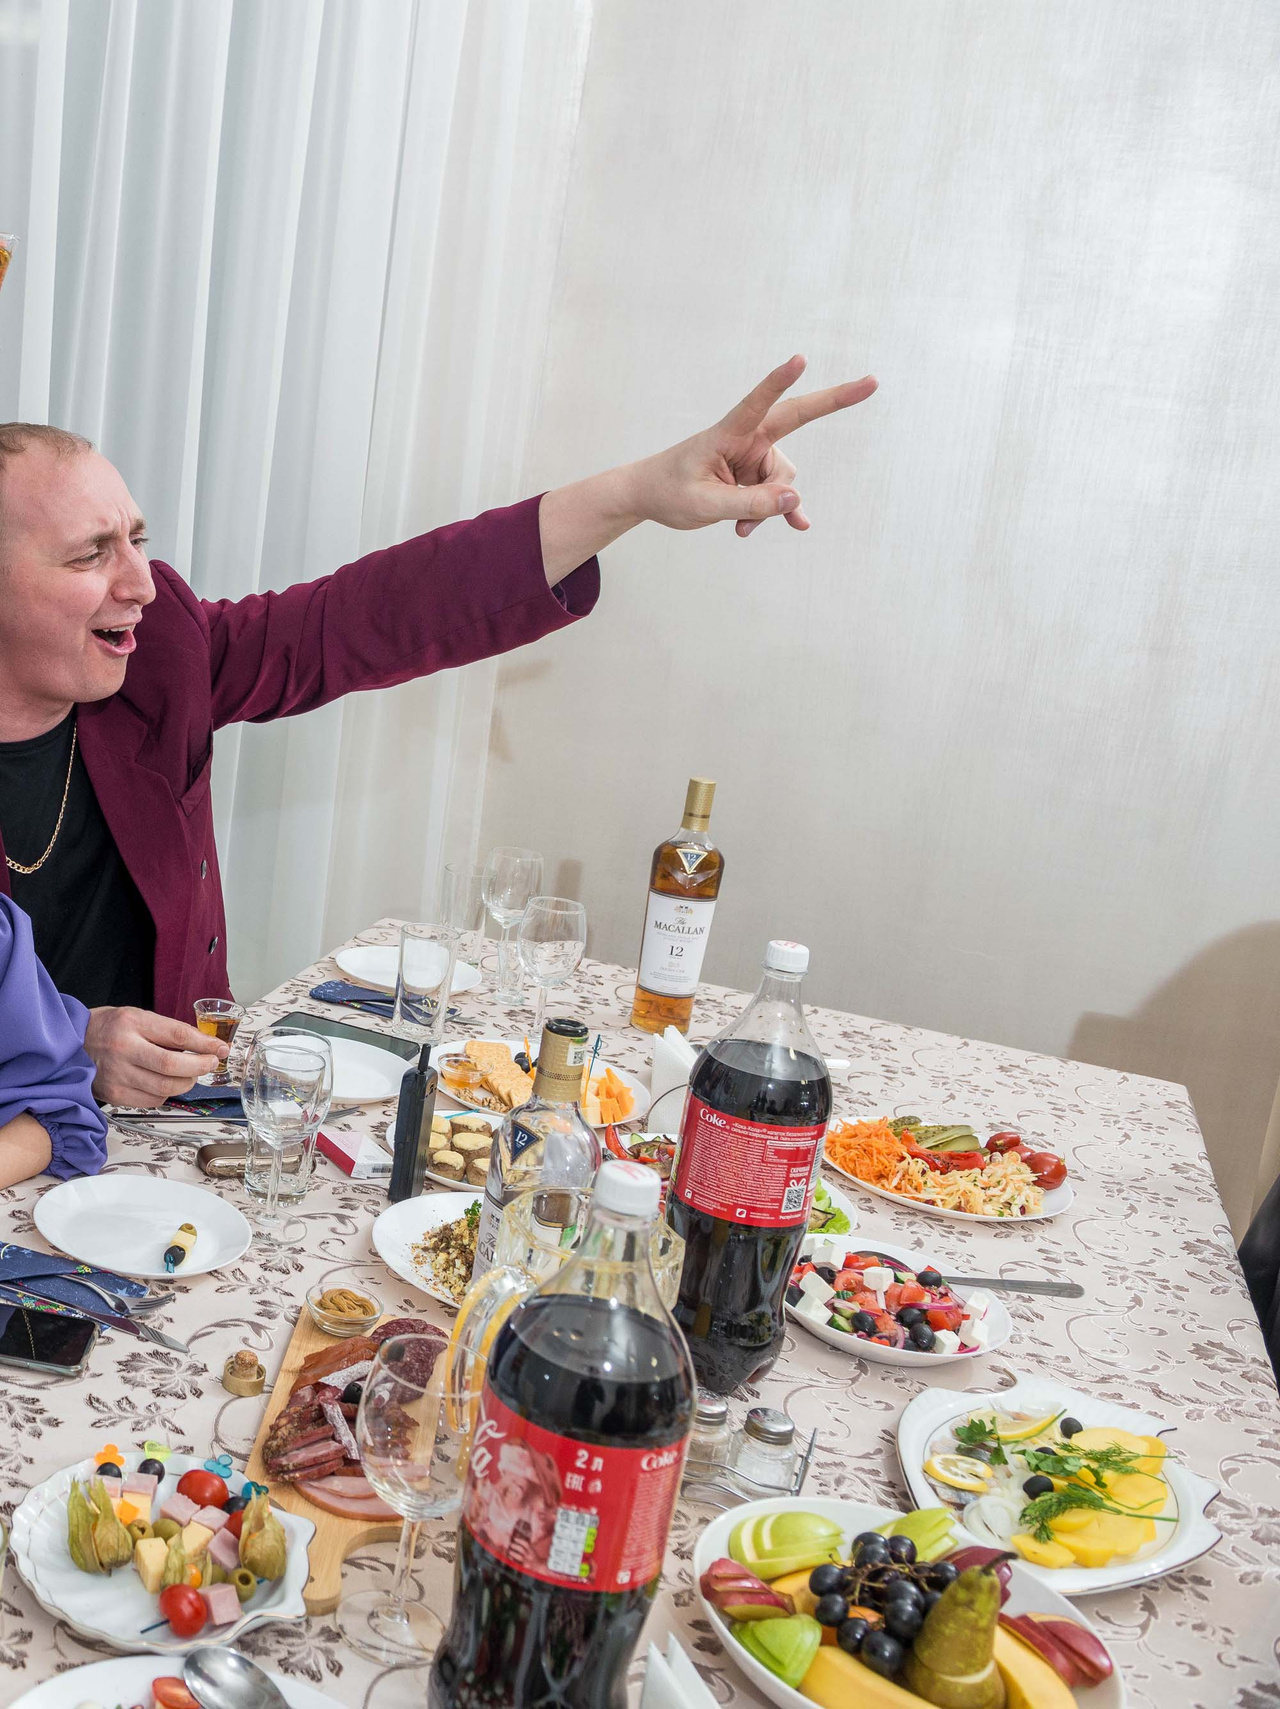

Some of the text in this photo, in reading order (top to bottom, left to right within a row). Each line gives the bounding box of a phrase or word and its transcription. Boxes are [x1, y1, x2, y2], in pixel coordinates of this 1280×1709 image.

[686, 853, 697, 862] 12
[653, 920, 705, 935] MACALLAN
[674, 916, 687, 926] The
[669, 945, 684, 957] 12
[699, 1107, 727, 1129] Coke
[514, 1130, 528, 1147] 12
[575, 1448, 589, 1470] 2
